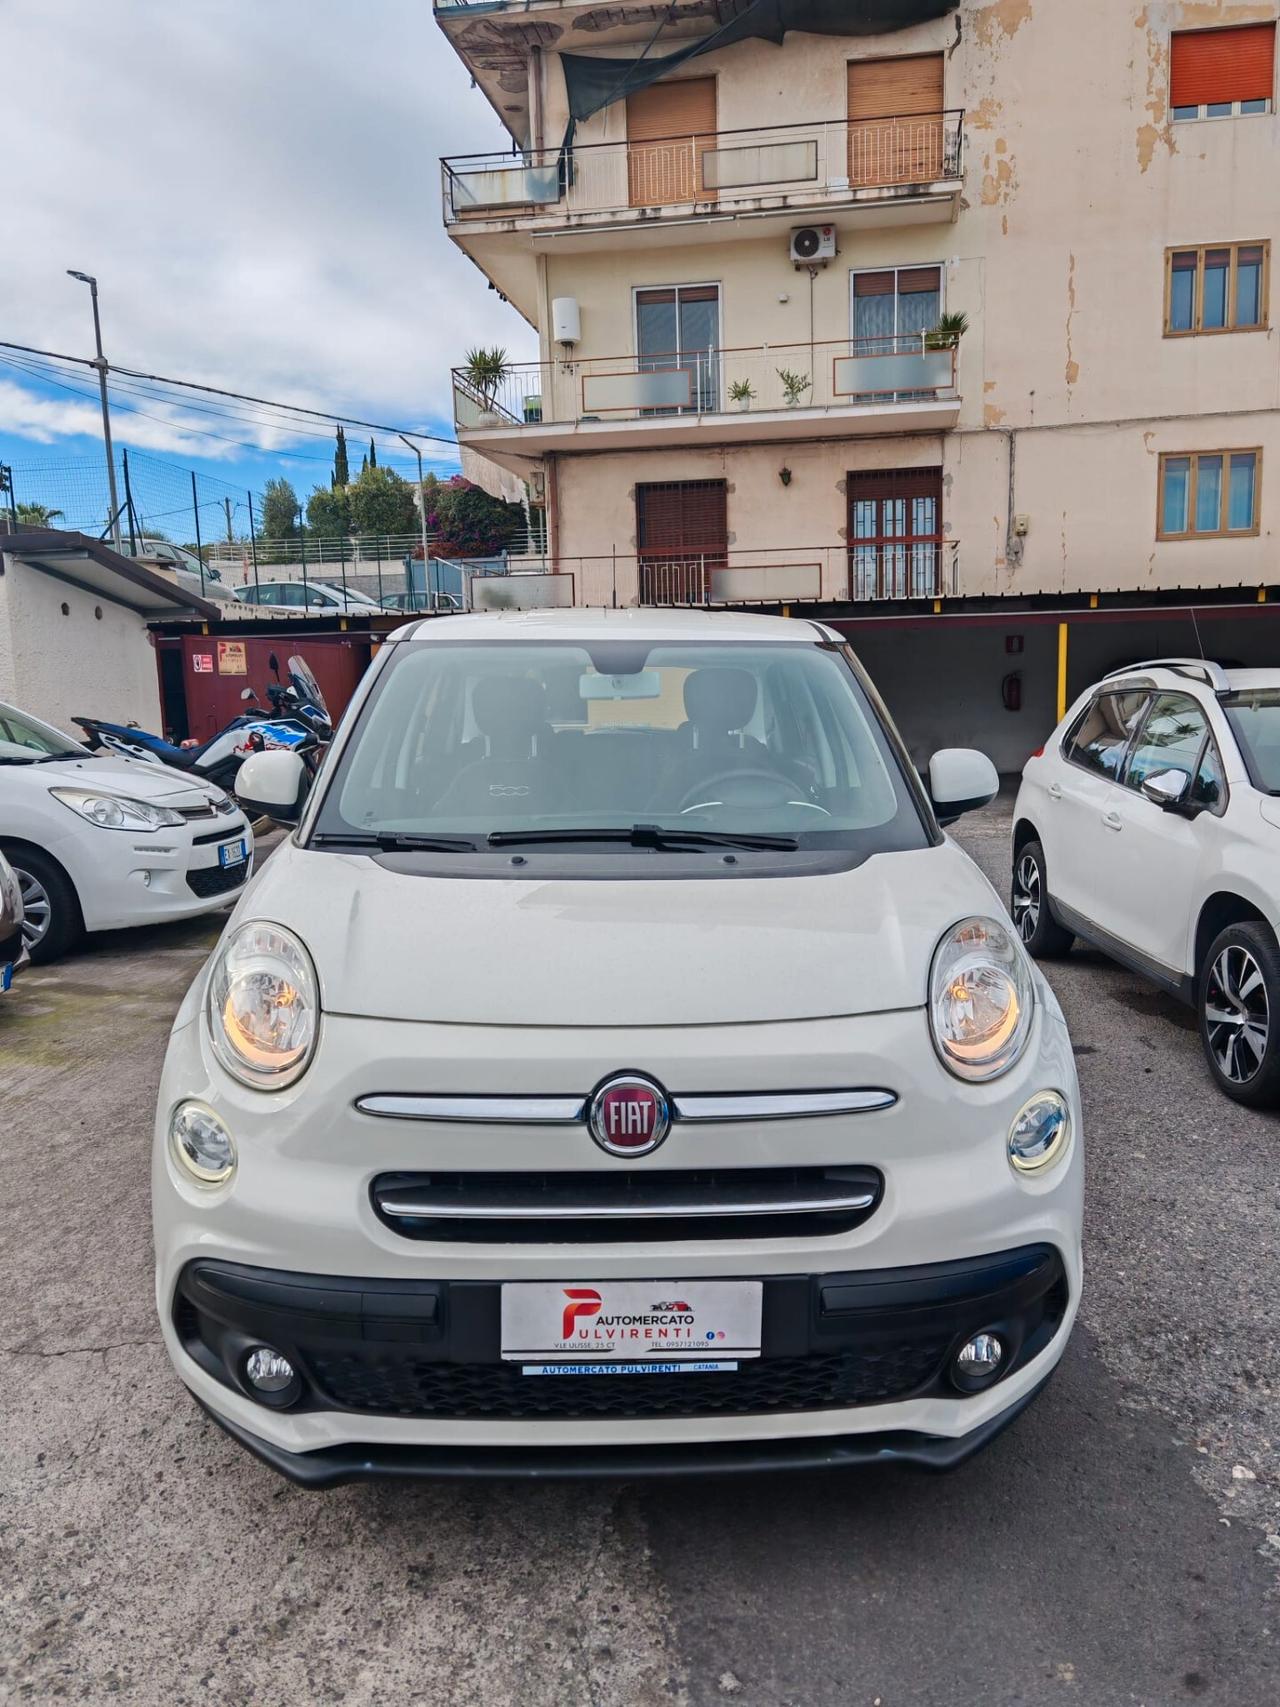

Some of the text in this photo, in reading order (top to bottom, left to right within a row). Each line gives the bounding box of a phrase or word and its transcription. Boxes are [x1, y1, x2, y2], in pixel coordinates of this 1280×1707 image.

[609, 1101, 652, 1135] FIAT
[595, 1315, 695, 1326] AUTOMERCATO
[542, 1364, 681, 1375] AUTOMERCATO PULVIRENTI
